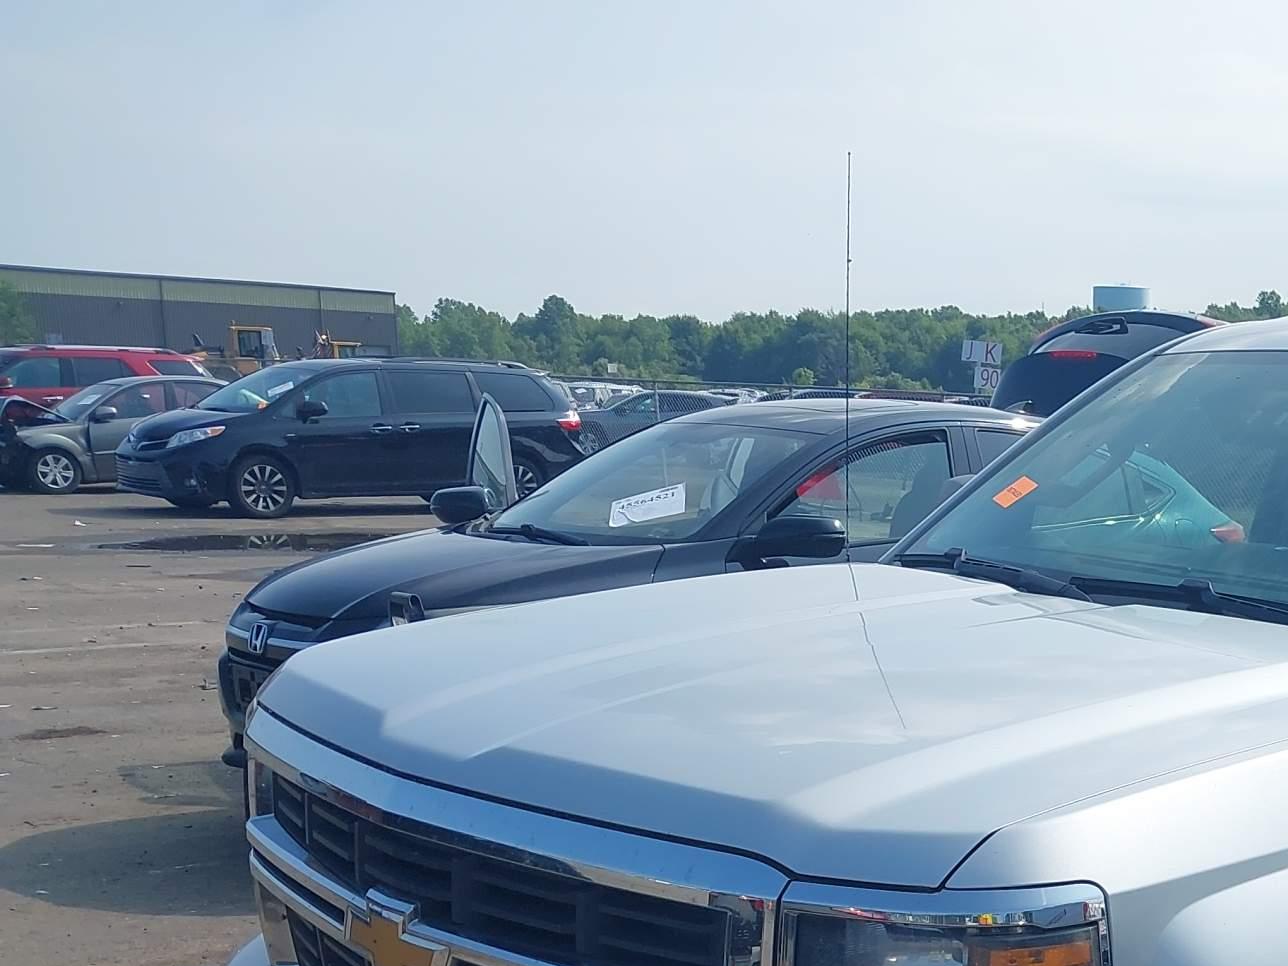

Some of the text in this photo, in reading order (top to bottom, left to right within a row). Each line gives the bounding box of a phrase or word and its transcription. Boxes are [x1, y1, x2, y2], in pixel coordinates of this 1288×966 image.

[965, 341, 998, 362] J K
[980, 368, 999, 389] 90
